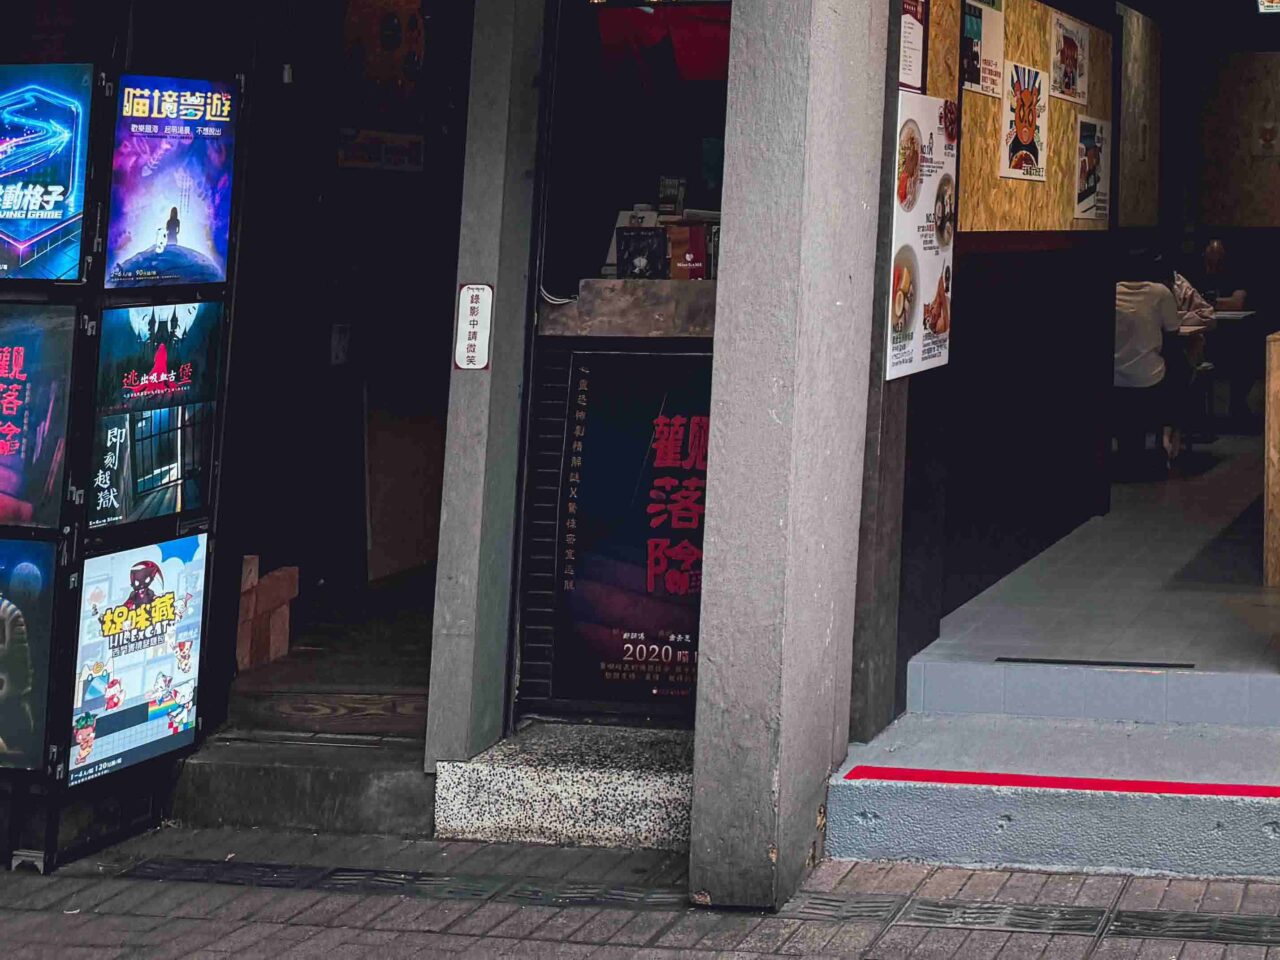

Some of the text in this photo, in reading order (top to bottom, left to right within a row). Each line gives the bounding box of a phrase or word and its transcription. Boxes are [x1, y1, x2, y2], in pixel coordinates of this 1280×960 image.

[0, 182, 64, 211] 動格子
[27, 210, 63, 219] GAME
[465, 294, 481, 366] 錄影中請微笑
[94, 427, 126, 511] 即刻越獄
[623, 644, 672, 662] 2020
